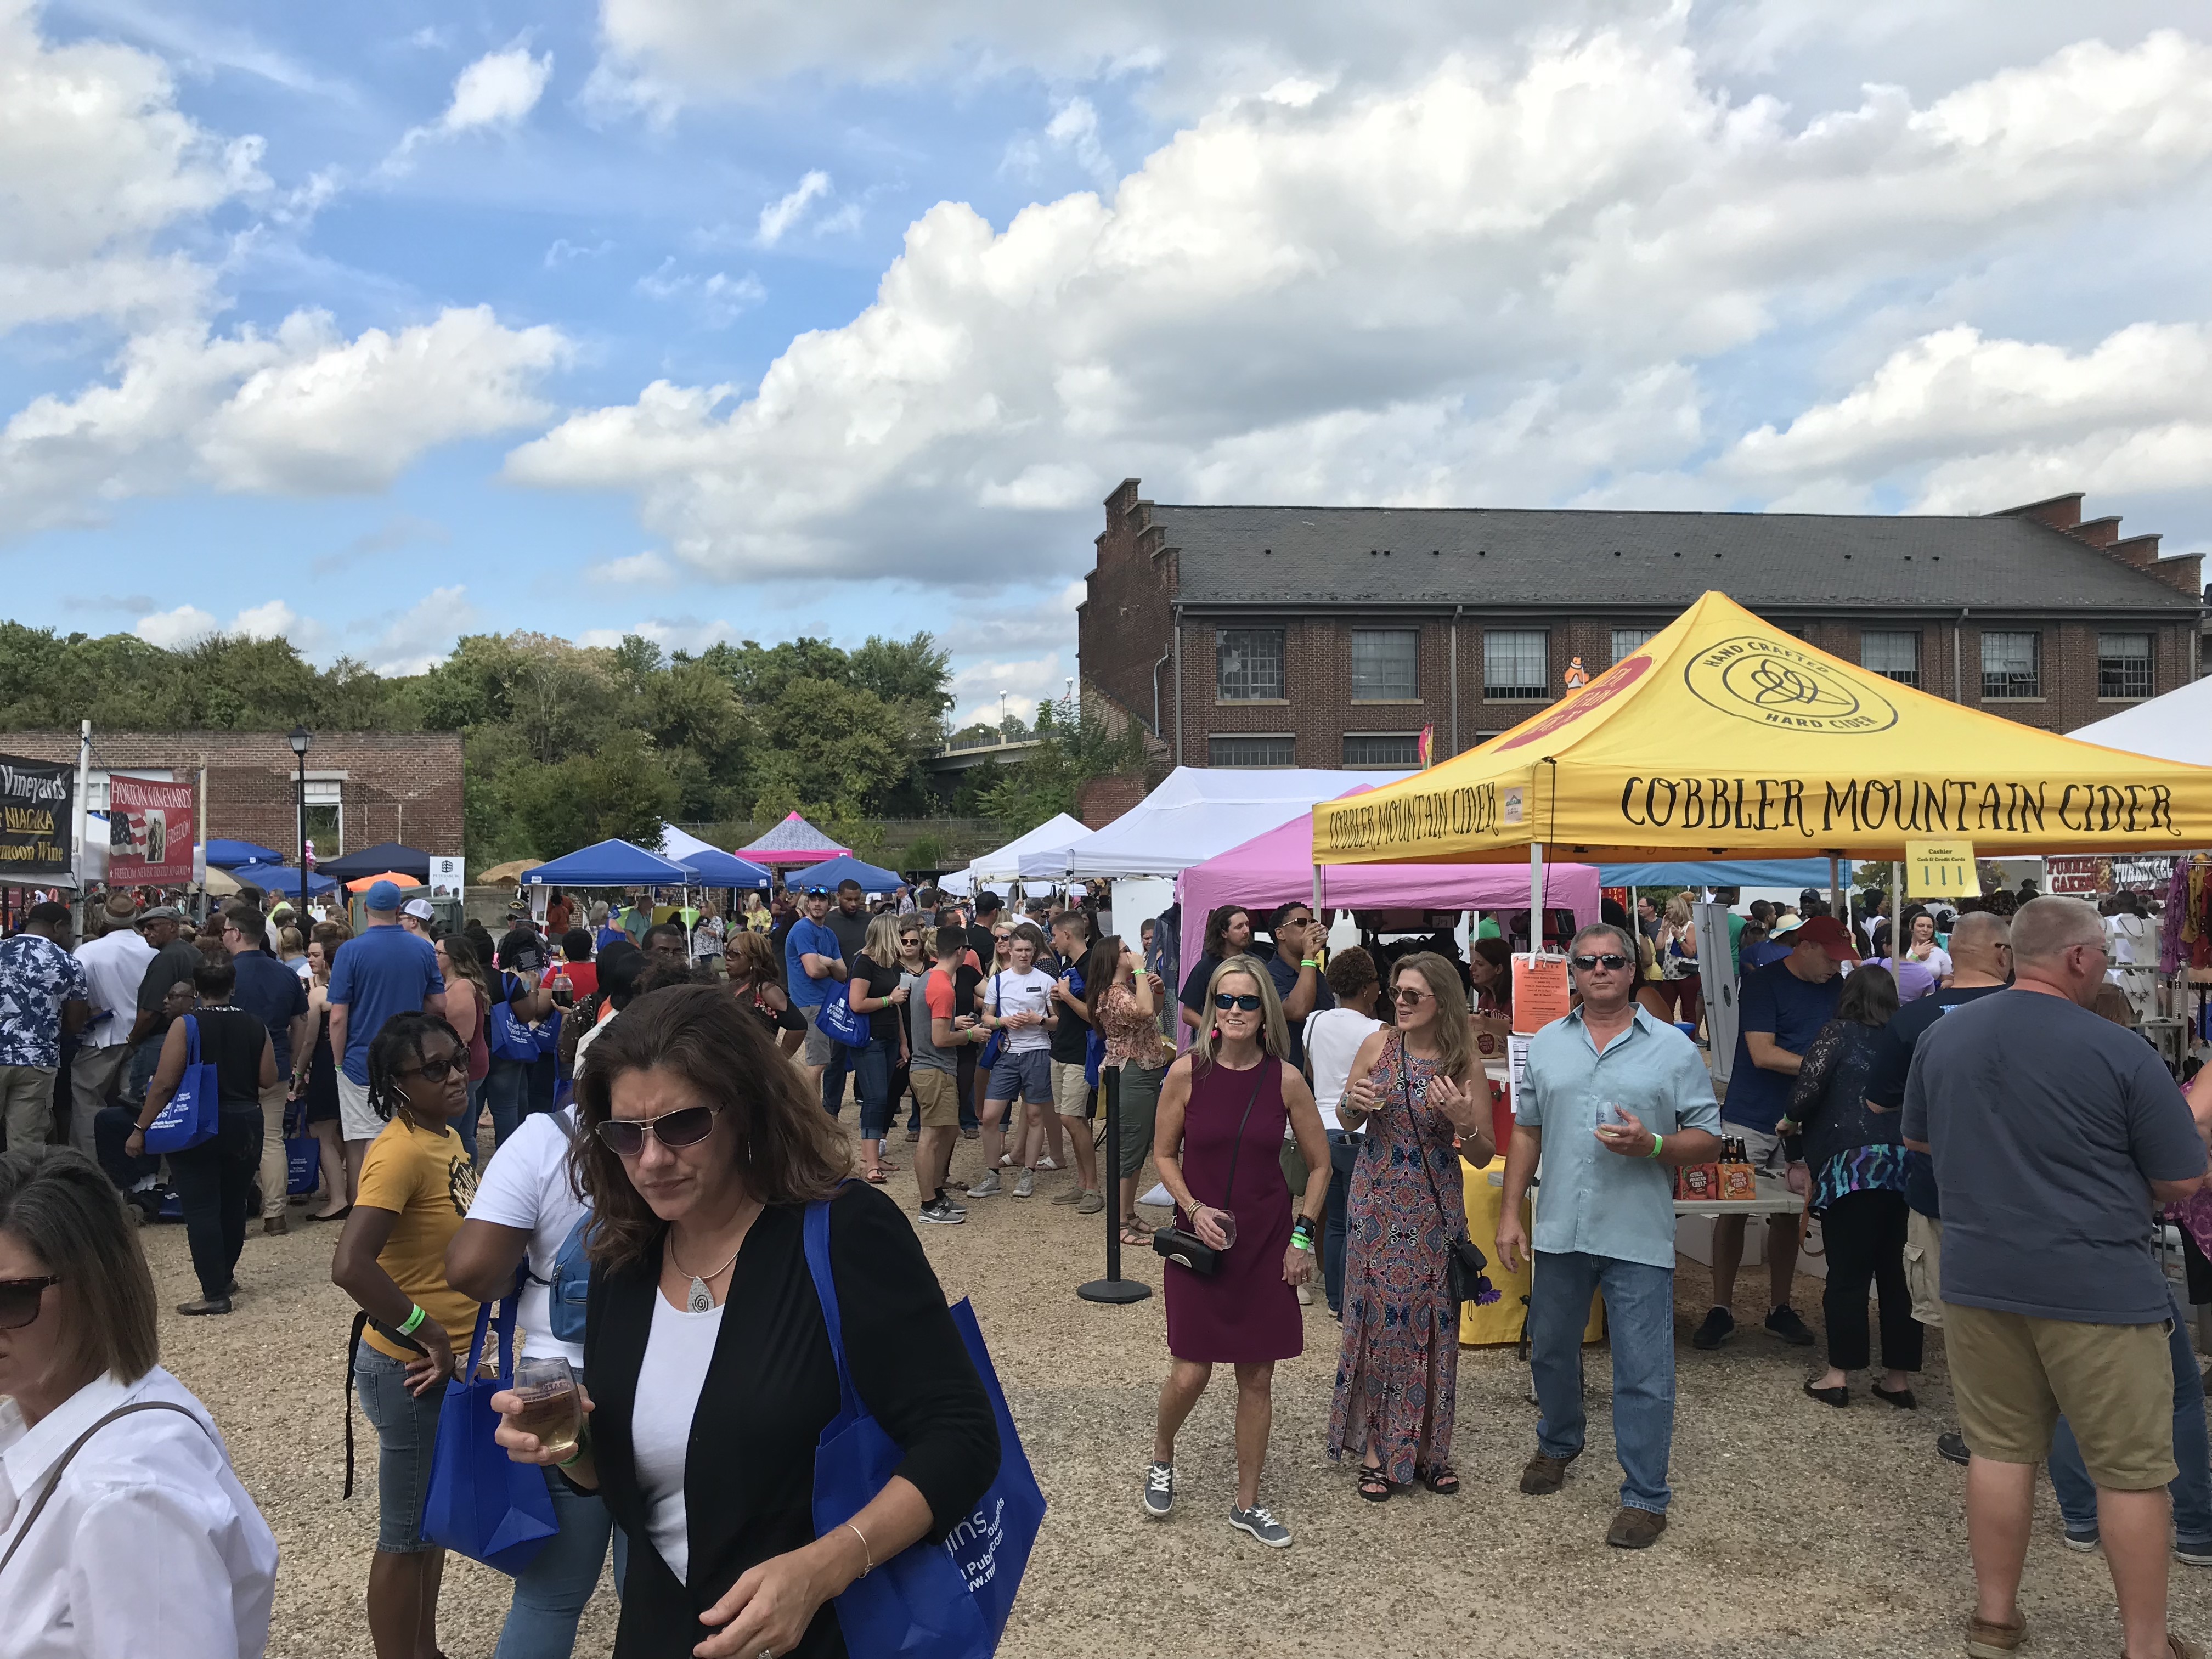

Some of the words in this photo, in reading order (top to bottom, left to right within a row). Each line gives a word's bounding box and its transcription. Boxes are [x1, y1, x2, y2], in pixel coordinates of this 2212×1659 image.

[1703, 645, 1744, 668] HAND
[1747, 641, 1829, 673] CRAFTED
[1765, 713, 1823, 729] HARD
[1831, 715, 1877, 729] CIDER
[111, 781, 148, 806] HORTON
[148, 786, 191, 808] VINEYARDS
[1621, 777, 1814, 837] COBBLER
[1822, 778, 2047, 833] MOUNTAIN
[2058, 784, 2181, 837] CIDER
[1330, 805, 1375, 851] COBBLER
[1377, 789, 1449, 845] MOUNTAIN
[1453, 782, 1499, 836] CIDER
[167, 820, 191, 847] FREEDOM
[2047, 857, 2097, 874] FUNNEL
[2052, 876, 2095, 893] CAKES
